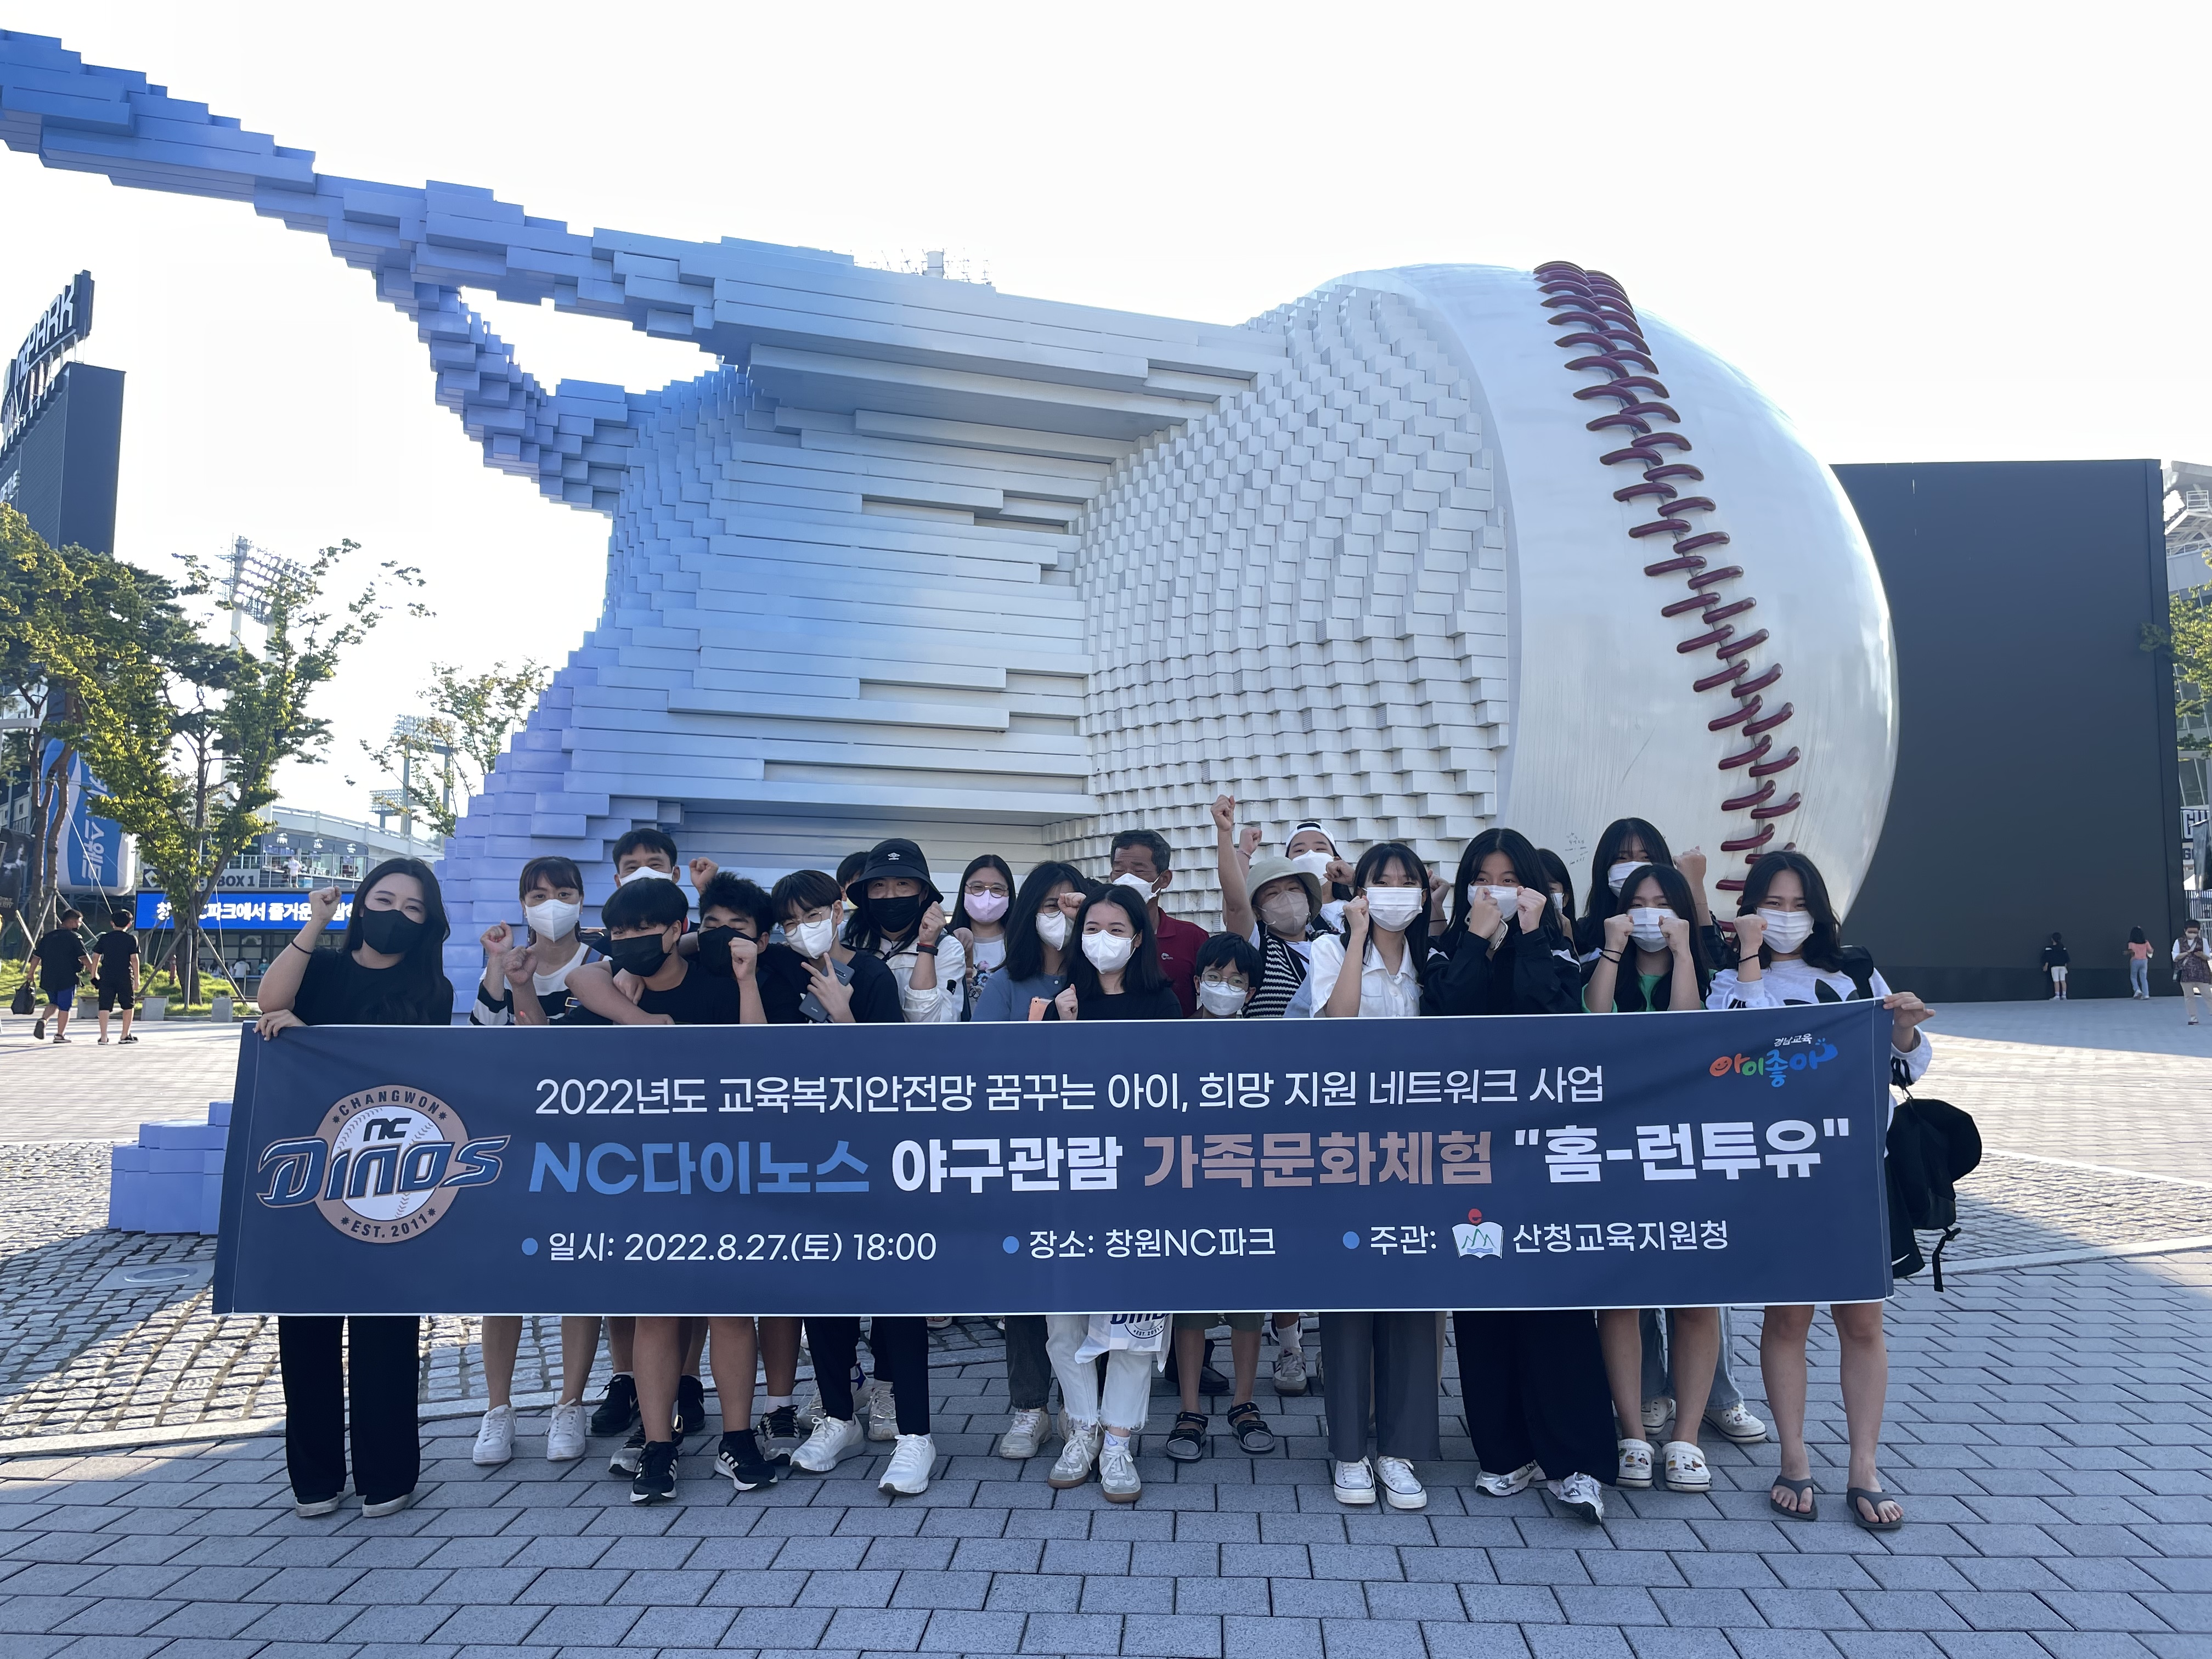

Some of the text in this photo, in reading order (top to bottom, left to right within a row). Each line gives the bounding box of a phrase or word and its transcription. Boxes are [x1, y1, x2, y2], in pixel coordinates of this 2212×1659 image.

[268, 902, 312, 921] 즐거운
[1774, 1033, 1813, 1047] 경남교육
[1709, 1036, 1838, 1088] 아이좋아
[338, 1090, 440, 1116] CHANGWON
[535, 1065, 1603, 1115] 2022년도 교육복지안전망 꿈꾸는 아이, 희망 지원 네트워크 사업
[529, 1118, 1850, 1195] NC다이노스 야구관람 가족문화체험 "홈-런투유"
[350, 1213, 428, 1238] EST. 2011
[1370, 1220, 1729, 1255] 주관: 산청교육지원청
[549, 1232, 937, 1262] 일시: 2022.8.27.(토) 18:00
[1030, 1228, 1276, 1259] 장소: 창원NC파크
